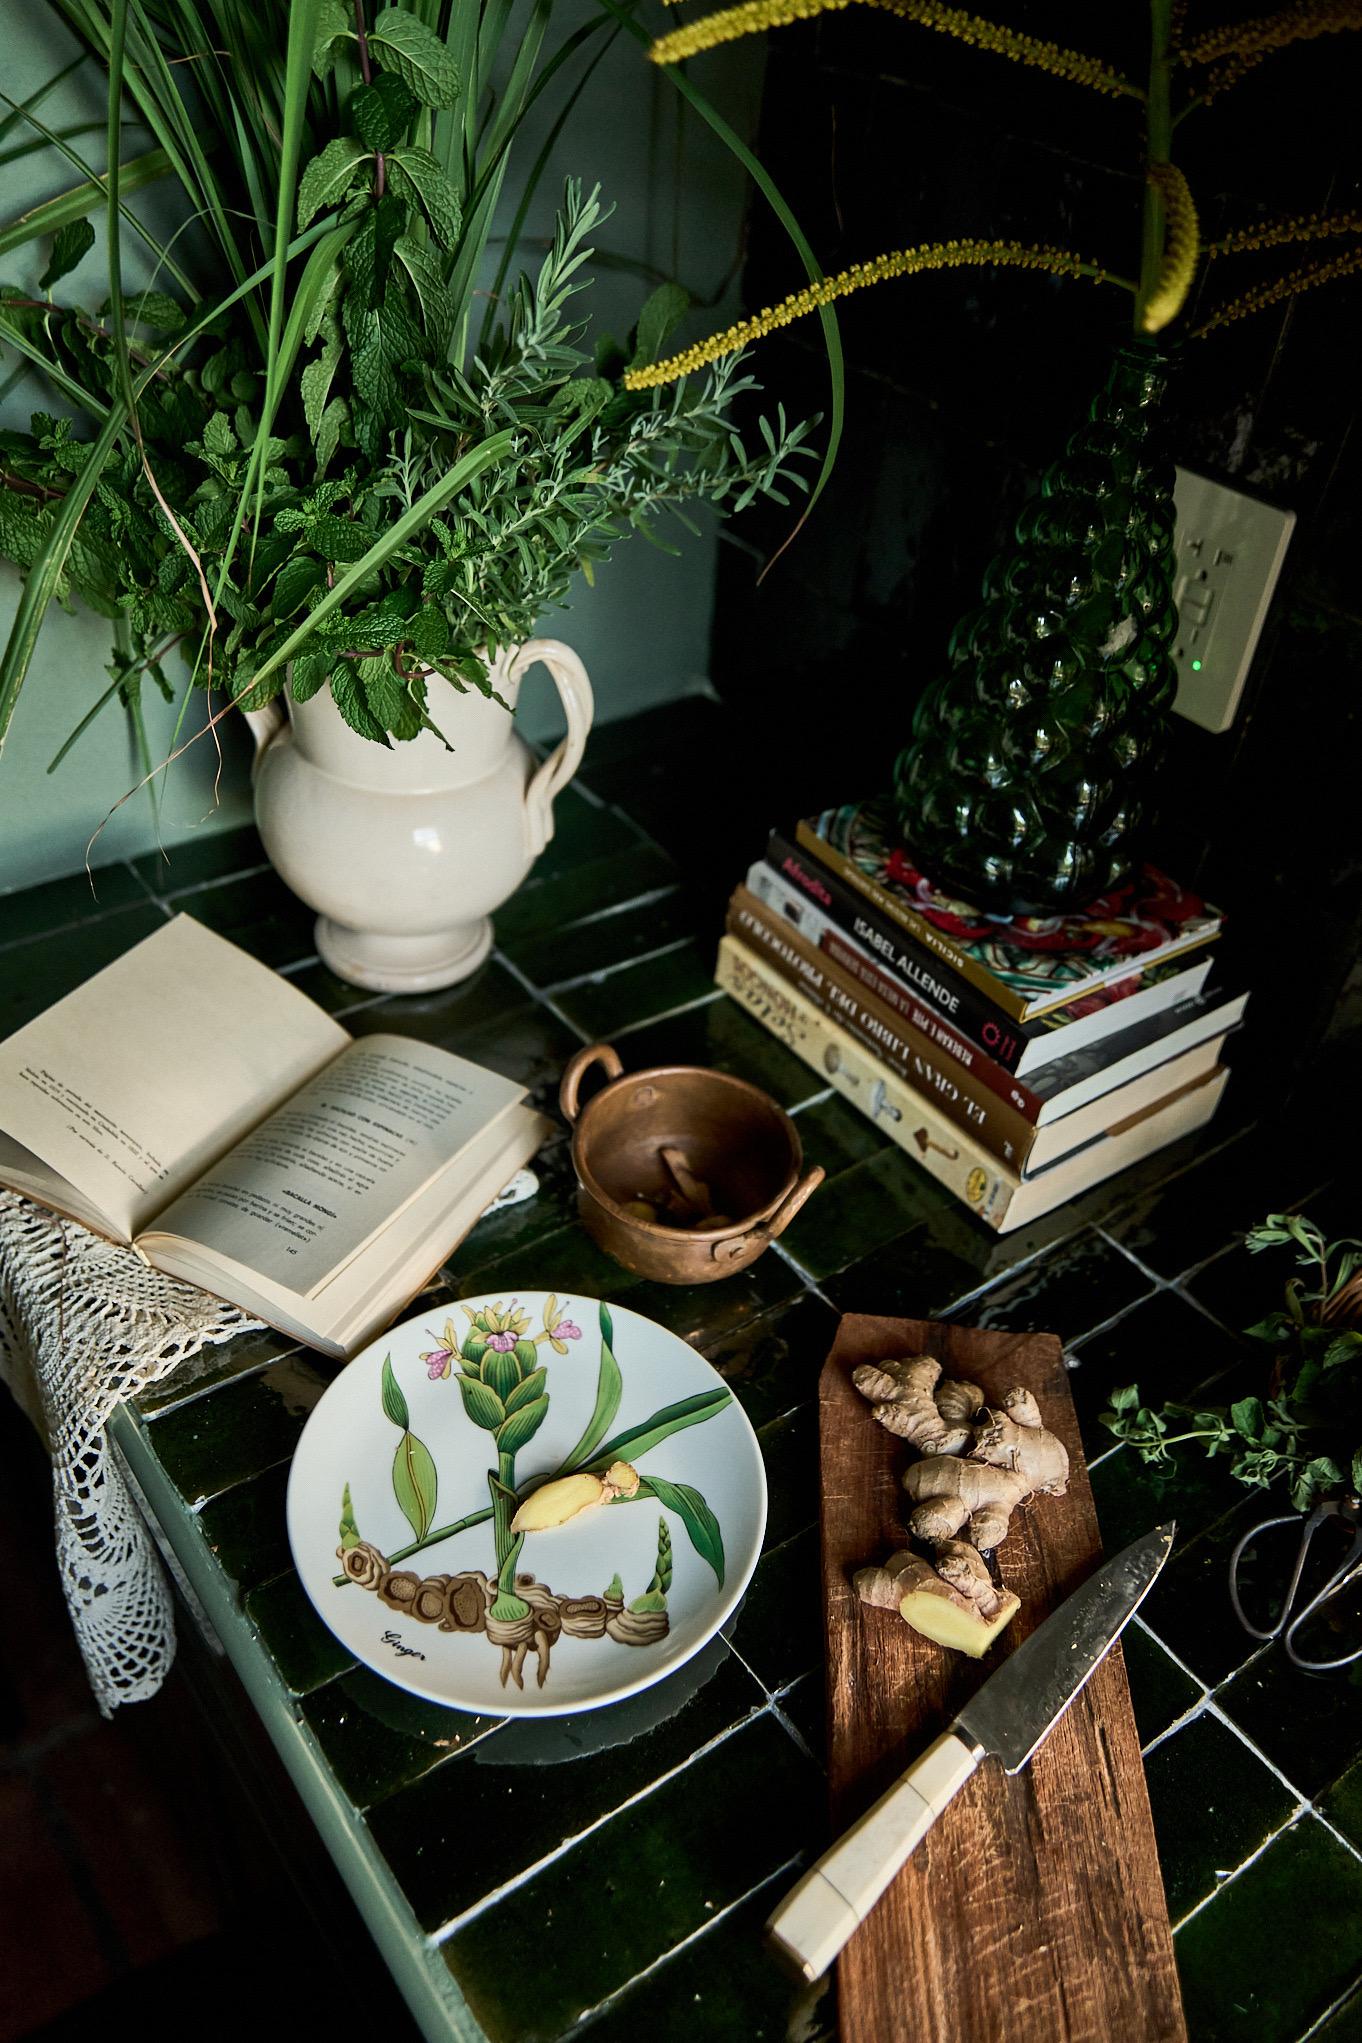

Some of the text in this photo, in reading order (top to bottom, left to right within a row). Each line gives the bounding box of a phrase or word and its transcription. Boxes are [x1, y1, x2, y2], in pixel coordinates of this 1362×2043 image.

[853, 917, 960, 1013] ISABEL ALLENDE
[925, 931, 965, 968] SICILIA
[827, 981, 858, 1021] DEL
[860, 1011, 911, 1061] LIBRO
[913, 1056, 960, 1101] GRAN
[965, 1094, 988, 1126] EL
